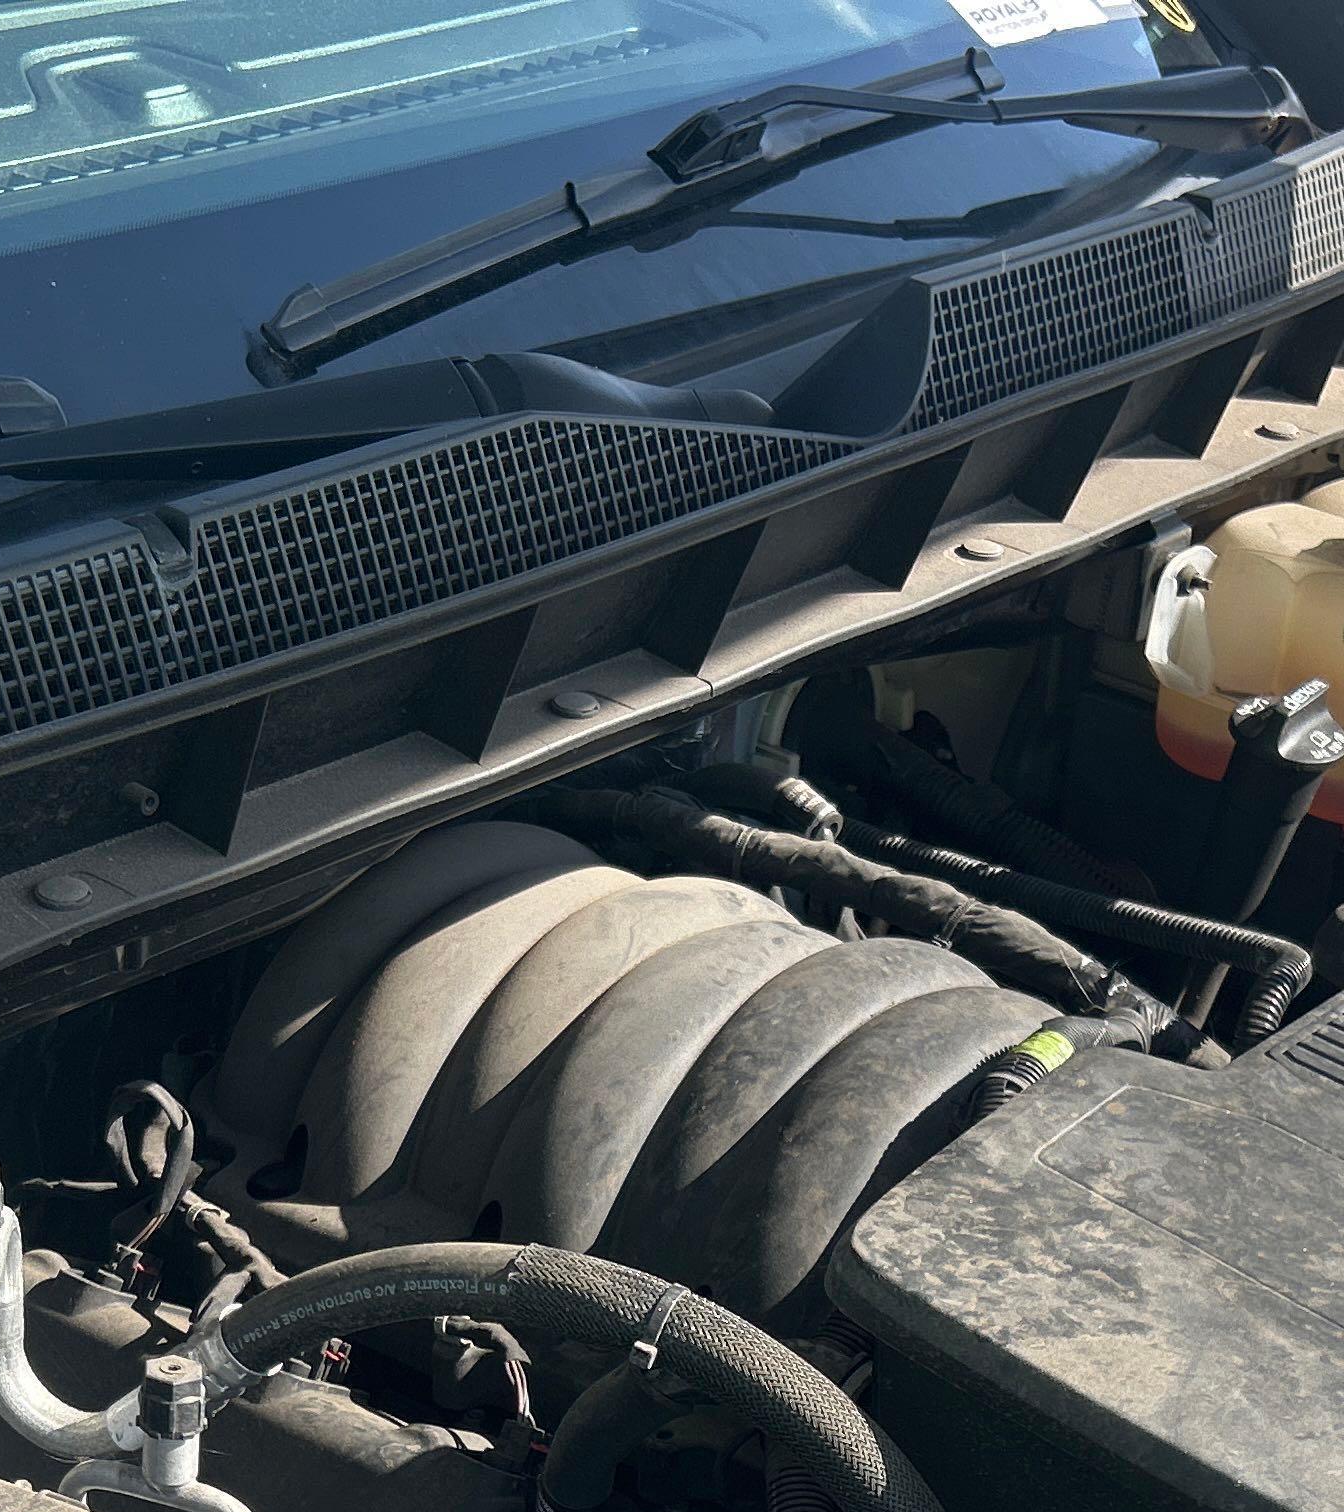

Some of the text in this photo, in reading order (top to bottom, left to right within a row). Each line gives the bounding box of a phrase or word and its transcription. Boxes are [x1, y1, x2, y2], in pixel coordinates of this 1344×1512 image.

[373, 1283, 397, 1297] A/C
[404, 1279, 480, 1295] Flexbarrier
[317, 1287, 372, 1310] SUCTION
[282, 1304, 315, 1326] HOSE
